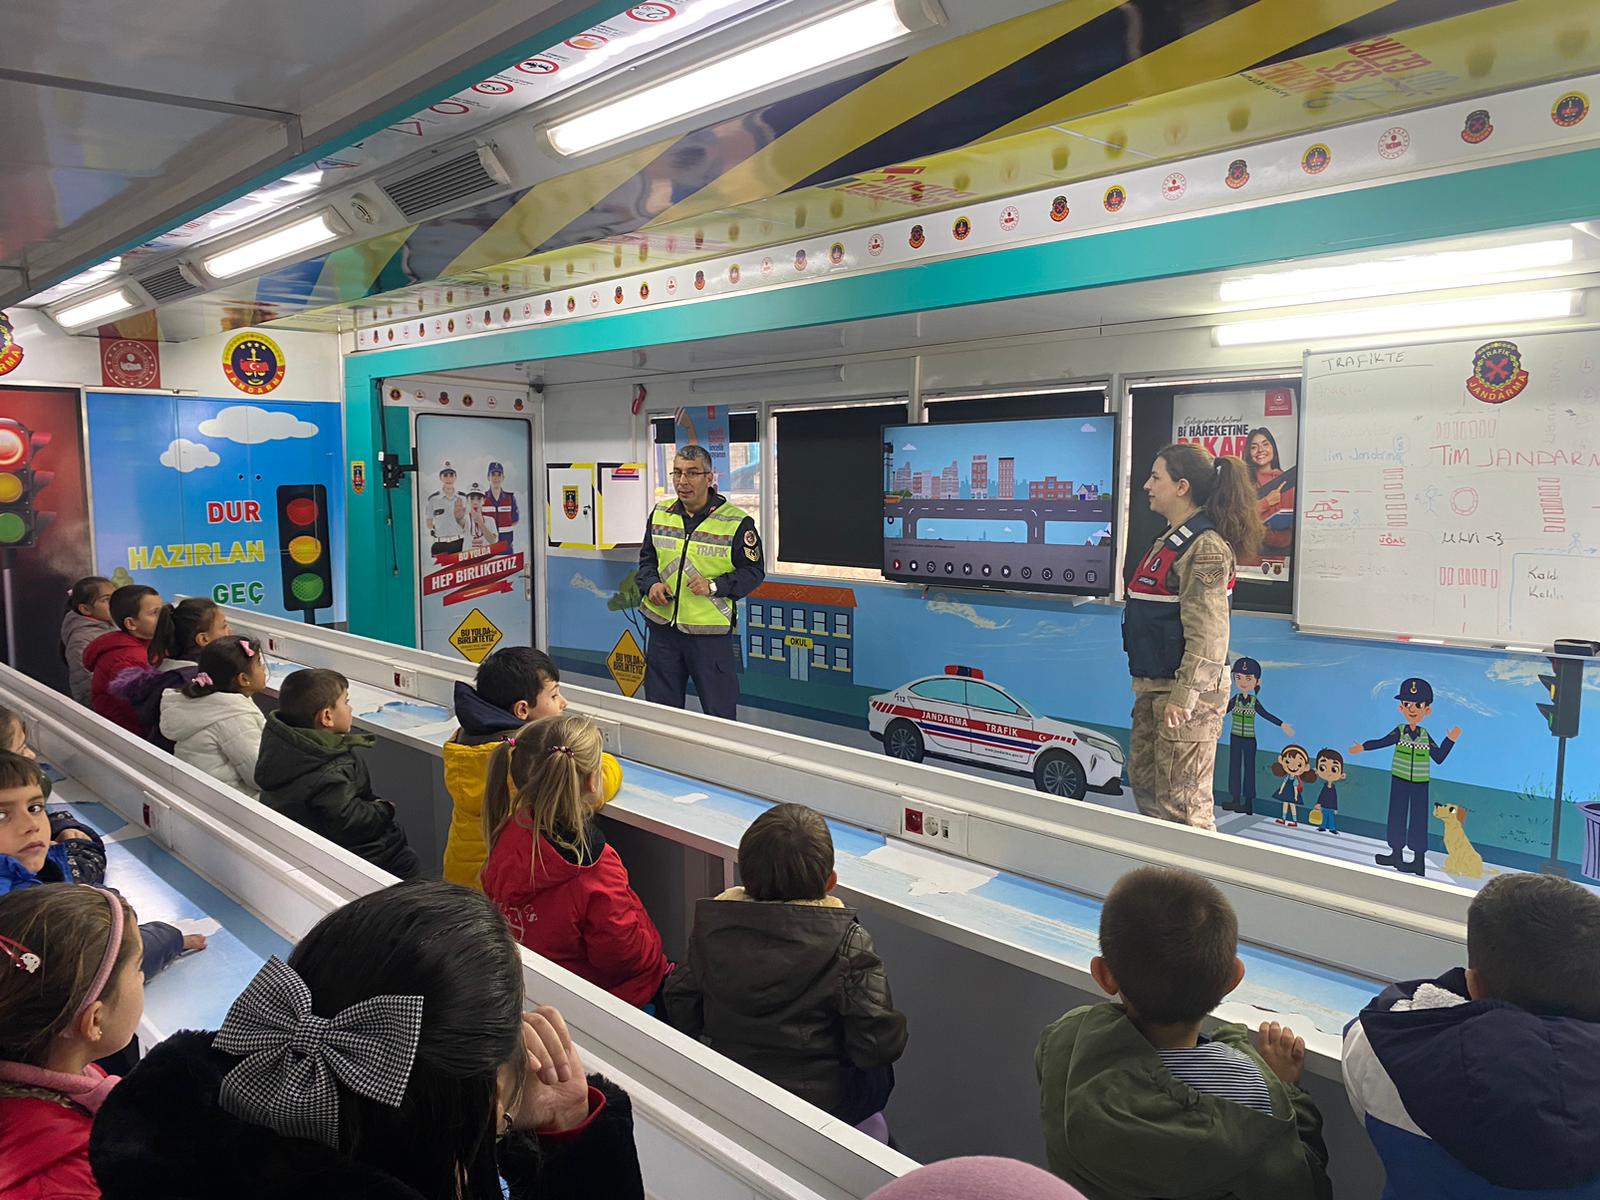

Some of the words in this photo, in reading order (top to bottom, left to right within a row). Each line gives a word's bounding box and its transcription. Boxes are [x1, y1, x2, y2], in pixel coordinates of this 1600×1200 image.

[226, 368, 284, 395] JANDARMA
[1469, 375, 1527, 400] JANDARMA
[207, 500, 261, 523] DUR
[128, 540, 265, 570] HAZIRLAN
[458, 552, 469, 561] BU
[470, 546, 491, 559] YOLDA
[432, 572, 454, 590] HEP
[212, 582, 265, 605] GEÇ
[790, 637, 808, 648] OKUL
[921, 711, 969, 727] JANDARMA
